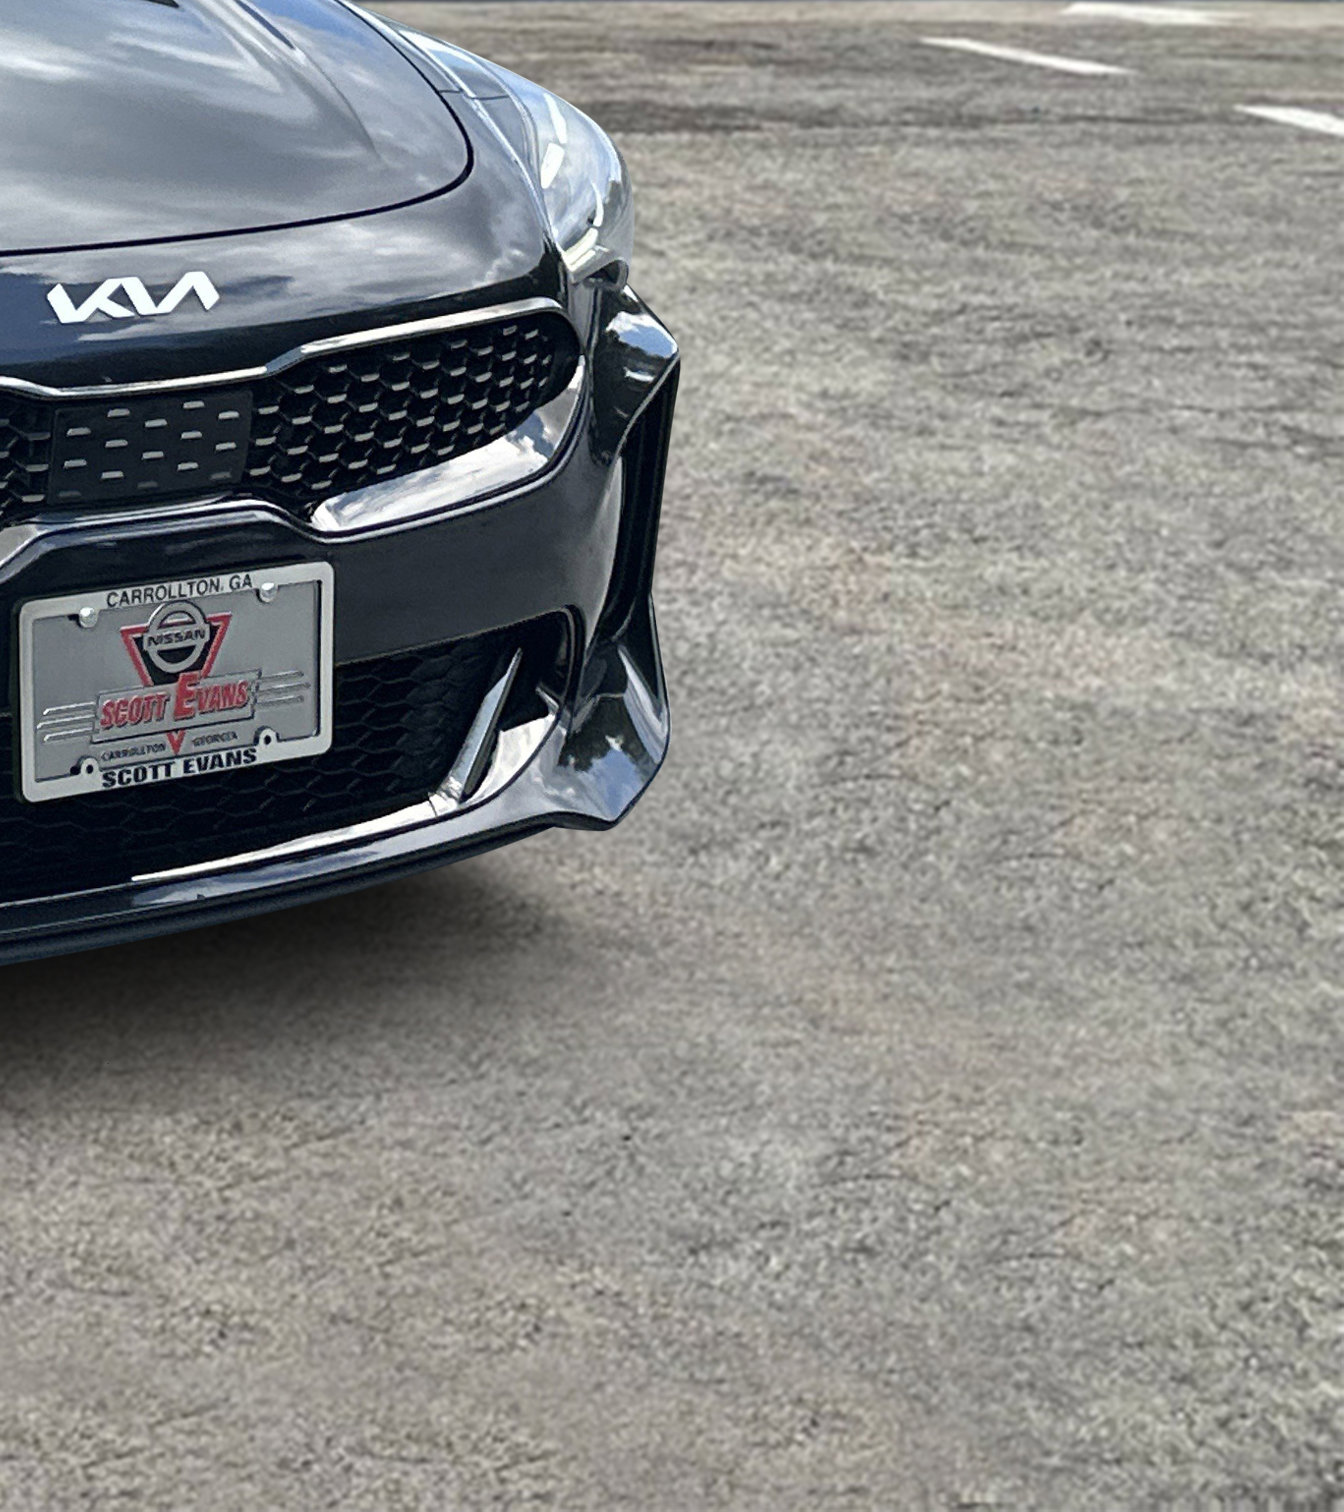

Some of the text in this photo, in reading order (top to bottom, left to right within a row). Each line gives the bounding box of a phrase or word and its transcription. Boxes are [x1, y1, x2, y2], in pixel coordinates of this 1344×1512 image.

[229, 574, 253, 589] GA
[148, 627, 206, 646] NISSAN
[100, 692, 170, 729] SCOTT
[102, 748, 257, 788] SCOTT EVANS
